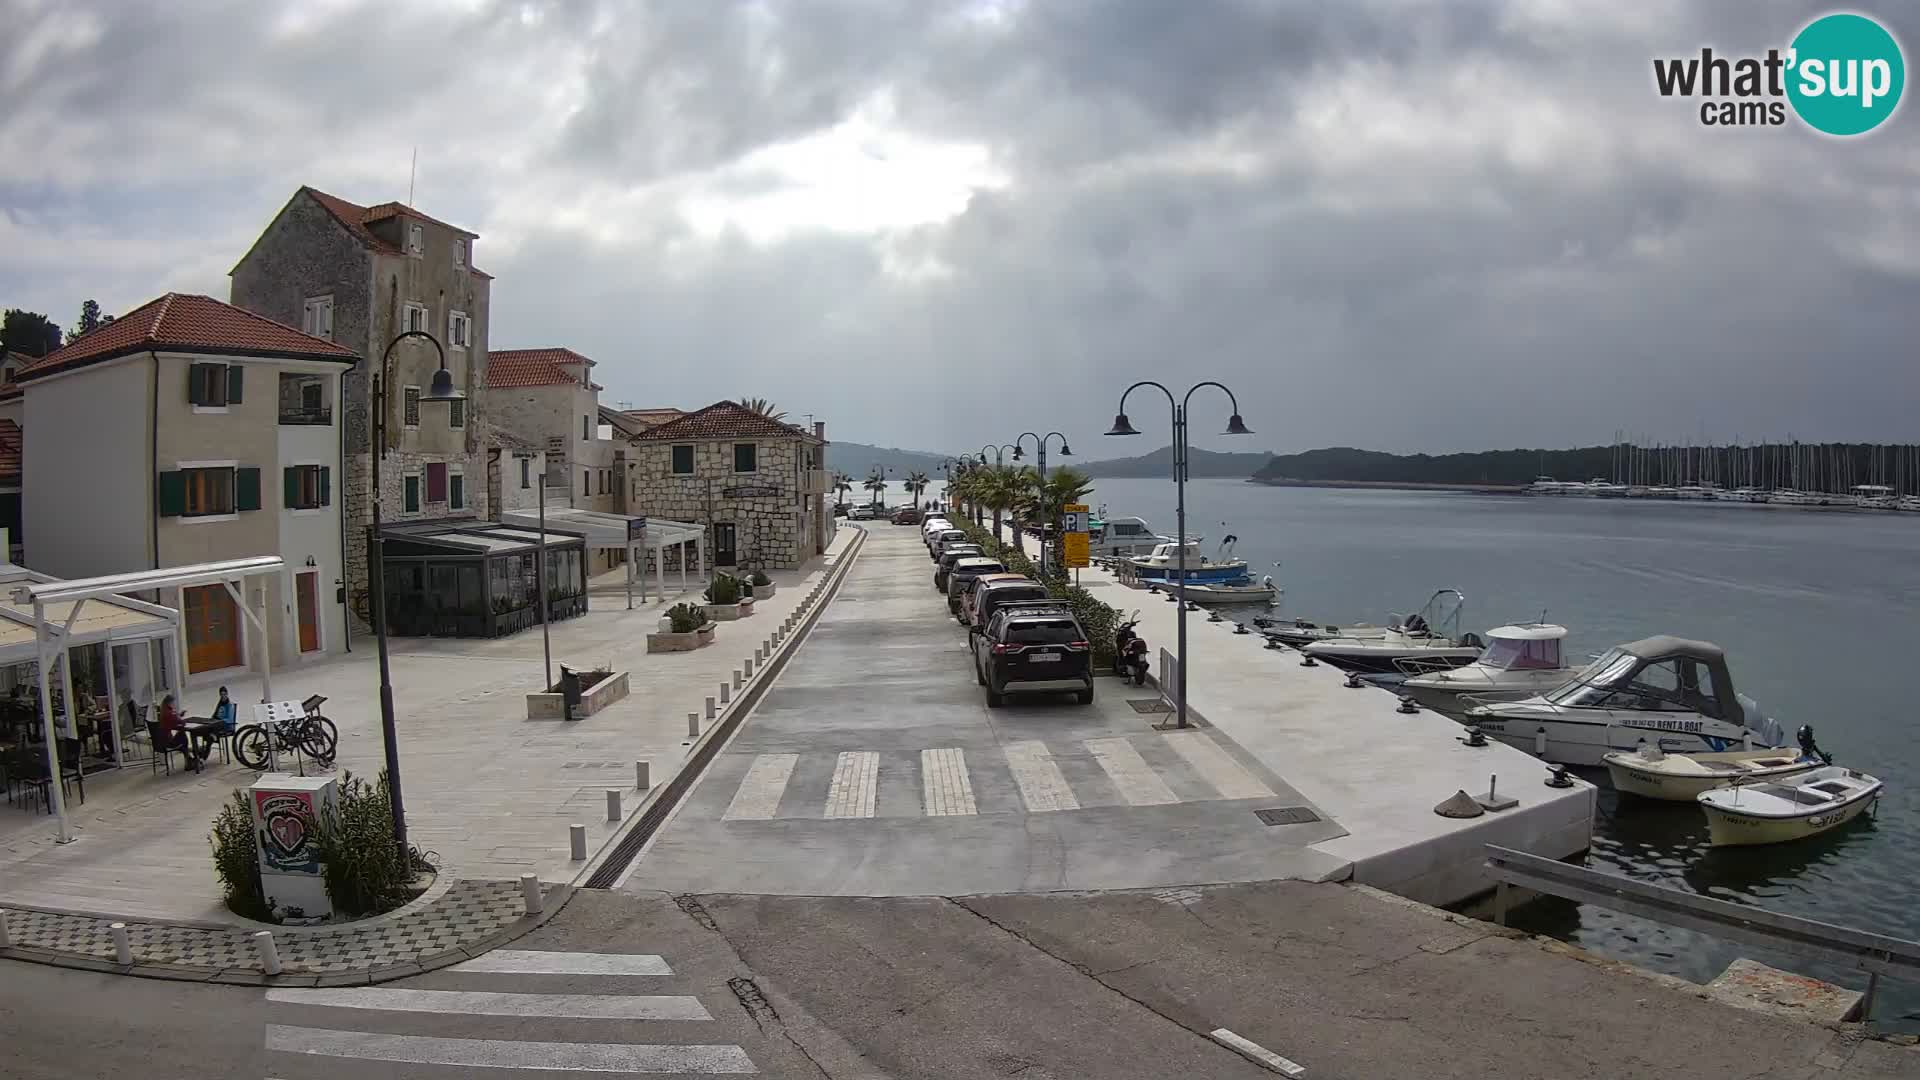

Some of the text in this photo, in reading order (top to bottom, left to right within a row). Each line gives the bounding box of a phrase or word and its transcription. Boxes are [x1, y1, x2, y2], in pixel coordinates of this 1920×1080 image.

[1066, 514, 1076, 530] P
[1657, 719, 1676, 730] RENT
[1677, 721, 1683, 731] A
[1684, 721, 1704, 733] BOAT
